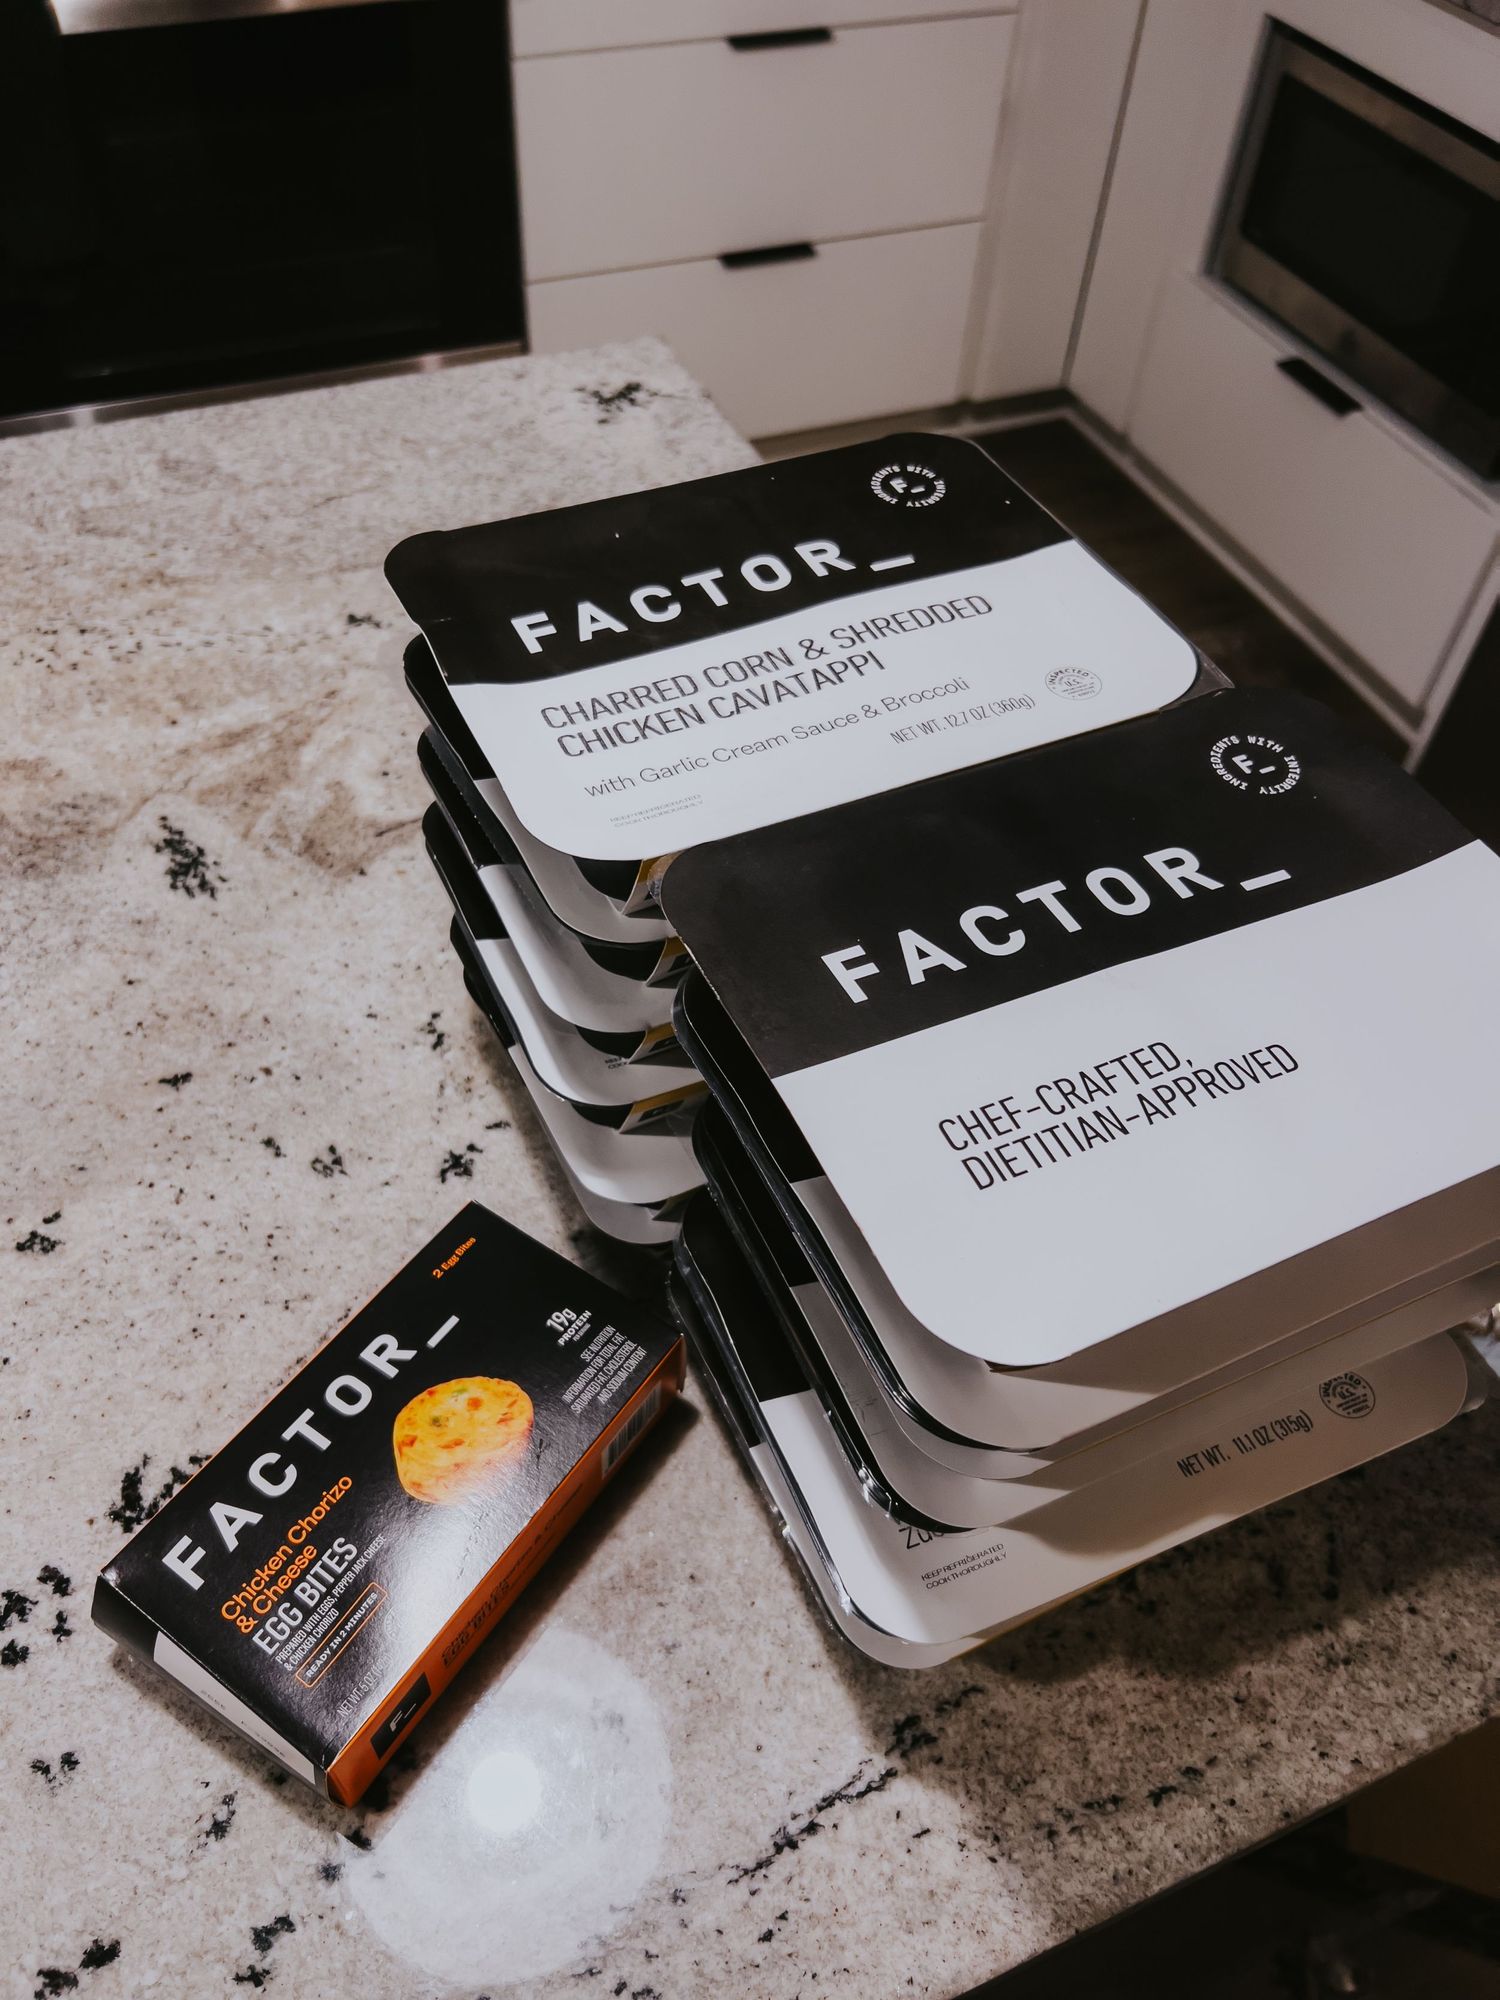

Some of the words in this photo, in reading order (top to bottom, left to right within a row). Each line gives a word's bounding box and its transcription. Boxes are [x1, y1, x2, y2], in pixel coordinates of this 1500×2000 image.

[540, 674, 699, 729] CHARRED
[702, 646, 795, 689] CORN
[798, 638, 826, 660] &
[830, 595, 993, 650] SHREDDED
[557, 704, 706, 757] CHICKEN
[708, 650, 886, 720] CAVATAPPI
[890, 726, 919, 744] NET
[916, 718, 946, 735] WT.
[944, 712, 969, 729] 12.7
[969, 705, 990, 721] OZ
[989, 693, 1036, 717] (360g)
[583, 775, 636, 798] with
[639, 754, 709, 782] Garlic
[711, 730, 790, 763] Cream
[791, 713, 859, 741] Sauce
[861, 704, 880, 719] &
[882, 677, 970, 712] Broccoli
[1210, 735, 1248, 790] INGREDIENTS
[1247, 735, 1284, 753] WITH
[1259, 755, 1301, 795] INTEGRITY
[937, 1040, 1195, 1153] CHEF-CRAFTED,
[962, 1042, 1300, 1191] DIETITIAN-APPROVED
[433, 1269, 444, 1278] 2
[441, 1254, 459, 1270] Egg
[455, 1237, 476, 1256] Bites
[546, 1308, 577, 1332] 19g
[558, 1310, 592, 1346] PROTEIN
[580, 1348, 594, 1362] SEE
[589, 1324, 616, 1352] NUTRITION
[562, 1365, 597, 1403] INFORMATION
[590, 1355, 606, 1370] FOR
[599, 1340, 618, 1360] TOTAL
[570, 1380, 601, 1414] SATURATED
[602, 1338, 637, 1375] CHOLESTEROL
[595, 1387, 613, 1404] AND
[605, 1367, 629, 1392] SODIUM
[622, 1346, 647, 1372] CONTENT
[1177, 1453, 1205, 1477] NET
[1201, 1444, 1231, 1468] WT.
[1232, 1433, 1256, 1455] 11.1
[1252, 1425, 1275, 1446] OZ
[1270, 1409, 1314, 1440] (315g)
[221, 1544, 293, 1620] Chicken
[288, 1476, 352, 1544] Chorizo
[921, 1567, 942, 1581] KEEP
[943, 1543, 1004, 1573] REFRIGERATED
[926, 1577, 951, 1589] COOK
[951, 1551, 1007, 1581] THOROUGHLY
[236, 1614, 259, 1634] &
[253, 1544, 318, 1614] Cheese
[253, 1602, 303, 1655] EGG
[294, 1537, 358, 1608] BITES
[276, 1630, 306, 1664] PREPARED
[303, 1612, 322, 1633] WITH
[319, 1597, 337, 1617] EGGS,
[332, 1571, 354, 1599] PEPPER
[351, 1555, 368, 1575] JACK
[364, 1534, 386, 1562] CHEESE
[344, 1592, 378, 1631] MINUTES
[284, 1661, 294, 1671] &
[290, 1631, 317, 1664] CHICKEN
[315, 1608, 340, 1638] CHORIZO
[330, 1636, 342, 1649] IN
[341, 1630, 348, 1638] 2
[306, 1649, 331, 1677] READY
[337, 1700, 354, 1718] NET
